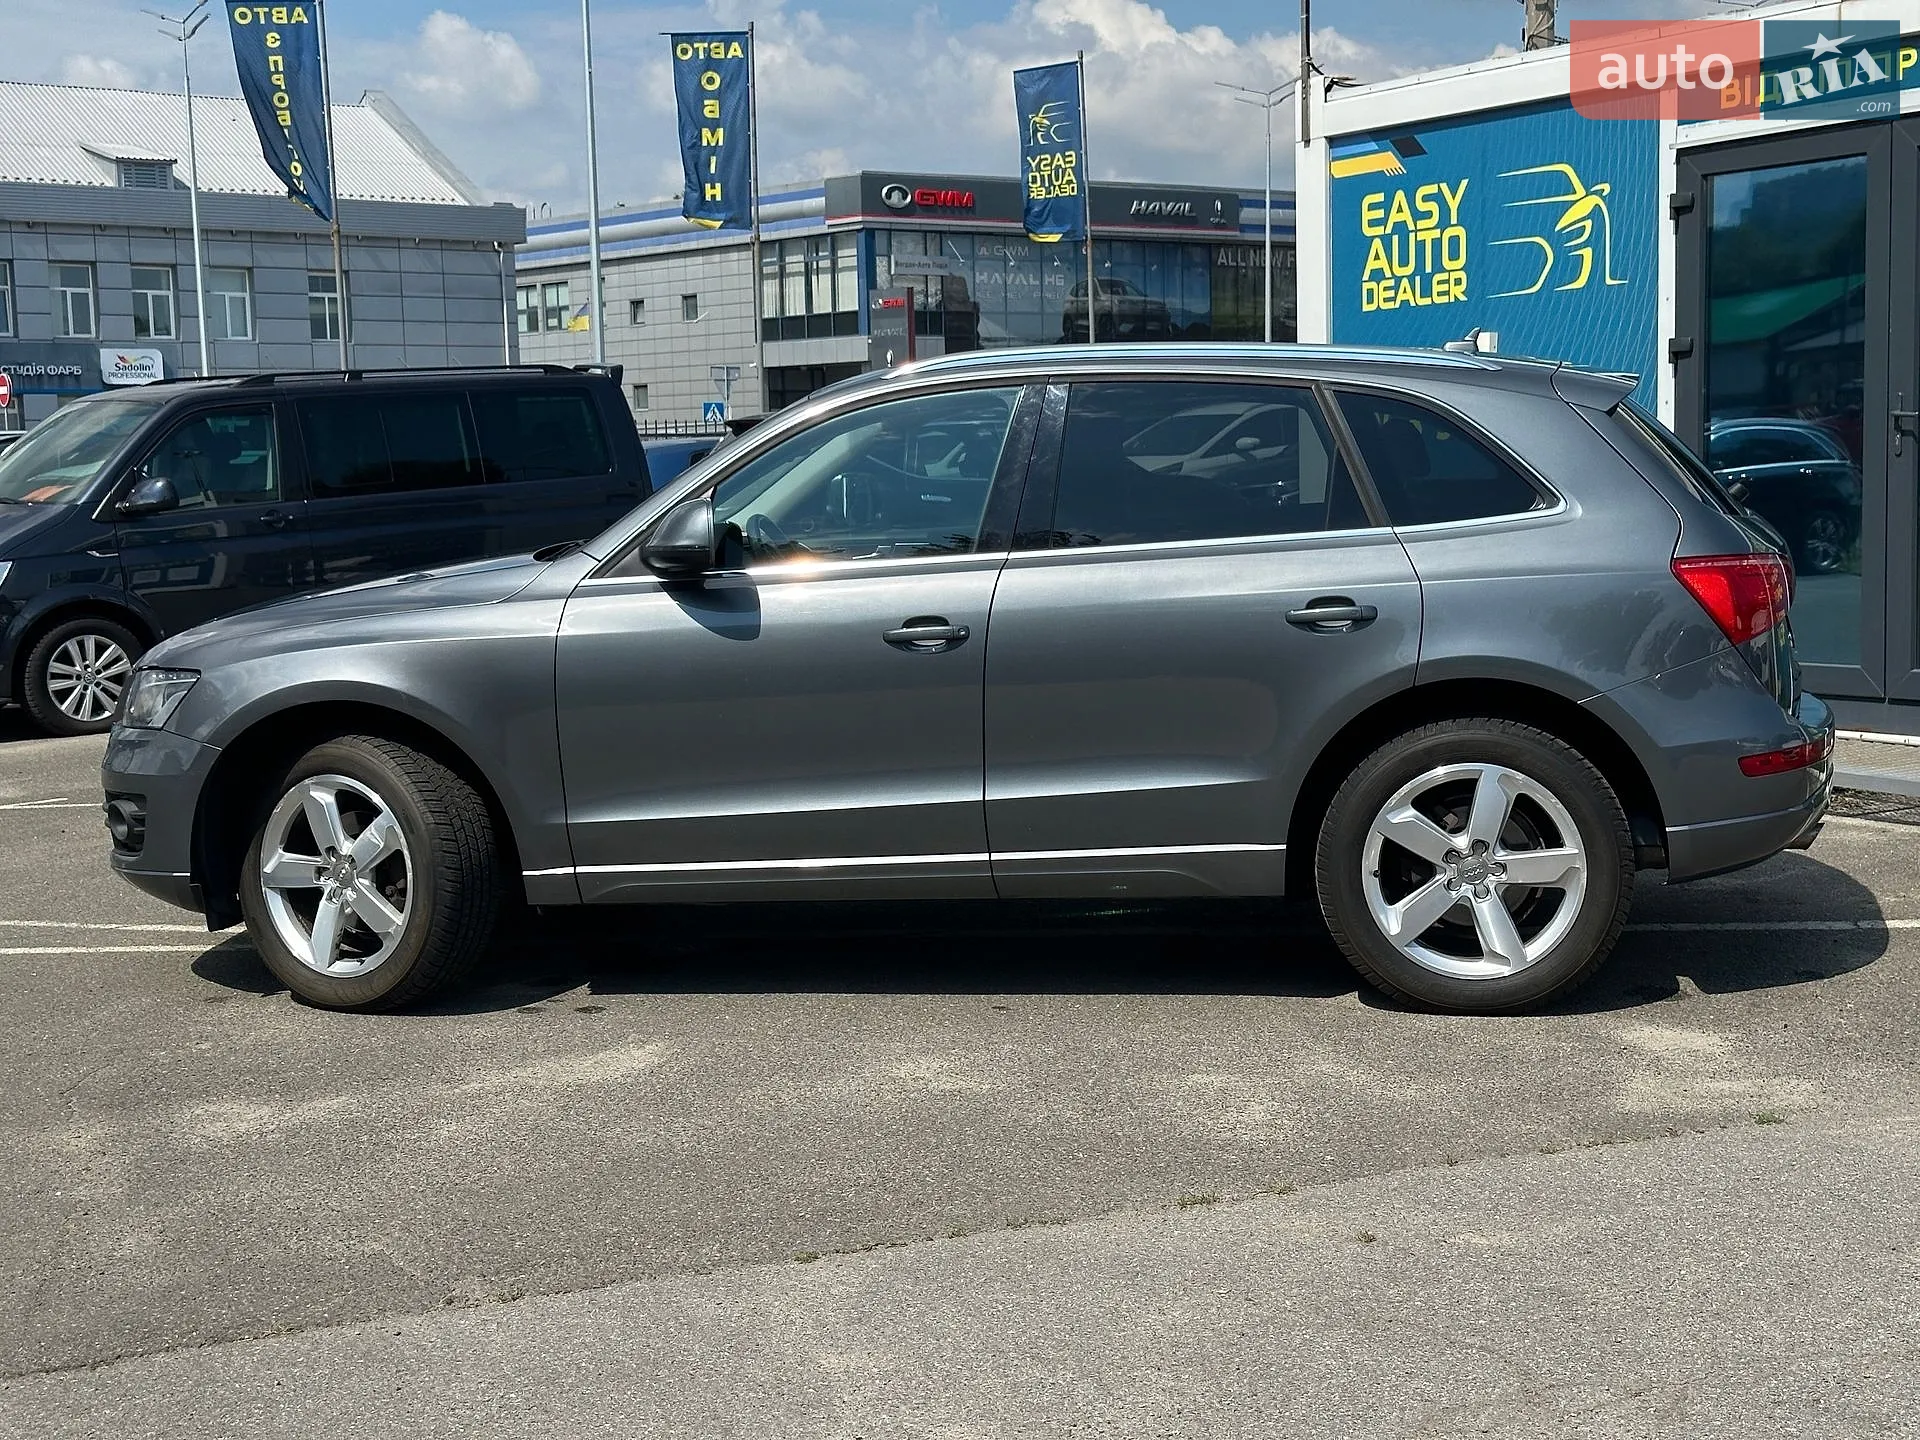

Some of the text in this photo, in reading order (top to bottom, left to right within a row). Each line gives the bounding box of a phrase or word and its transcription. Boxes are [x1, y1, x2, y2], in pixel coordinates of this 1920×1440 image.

[914, 188, 974, 208] GWM
[1361, 178, 1469, 237] EASY
[1130, 200, 1197, 217] HAVAL
[1217, 247, 1246, 267] ALL
[1361, 226, 1467, 281] AUTO
[975, 271, 1040, 286] HAVAL
[1362, 270, 1468, 312] DEALER
[47, 364, 82, 376] ФАРБ
[108, 371, 158, 379] PROFESSIONAL
